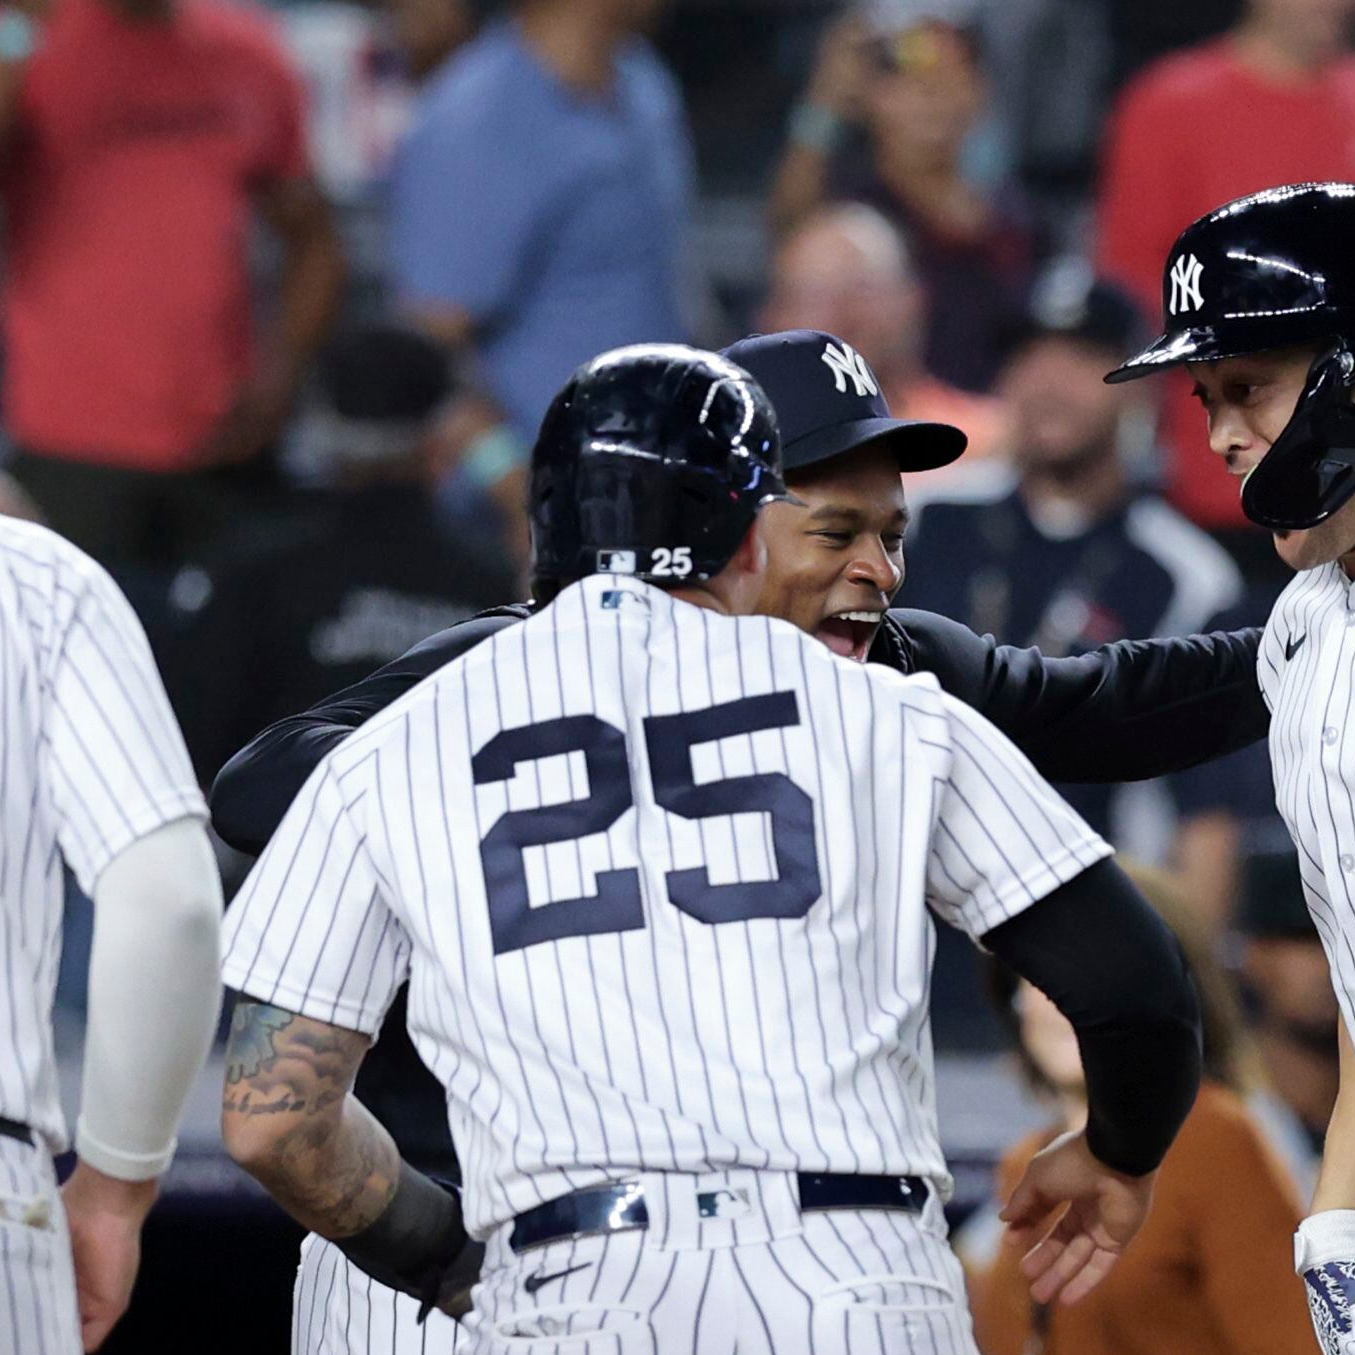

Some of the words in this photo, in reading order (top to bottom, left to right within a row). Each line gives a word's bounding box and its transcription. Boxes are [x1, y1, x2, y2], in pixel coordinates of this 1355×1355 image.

[1168, 252, 1205, 317] NY
[820, 341, 878, 397] NY
[650, 546, 694, 577] 25
[470, 688, 823, 957] 25
